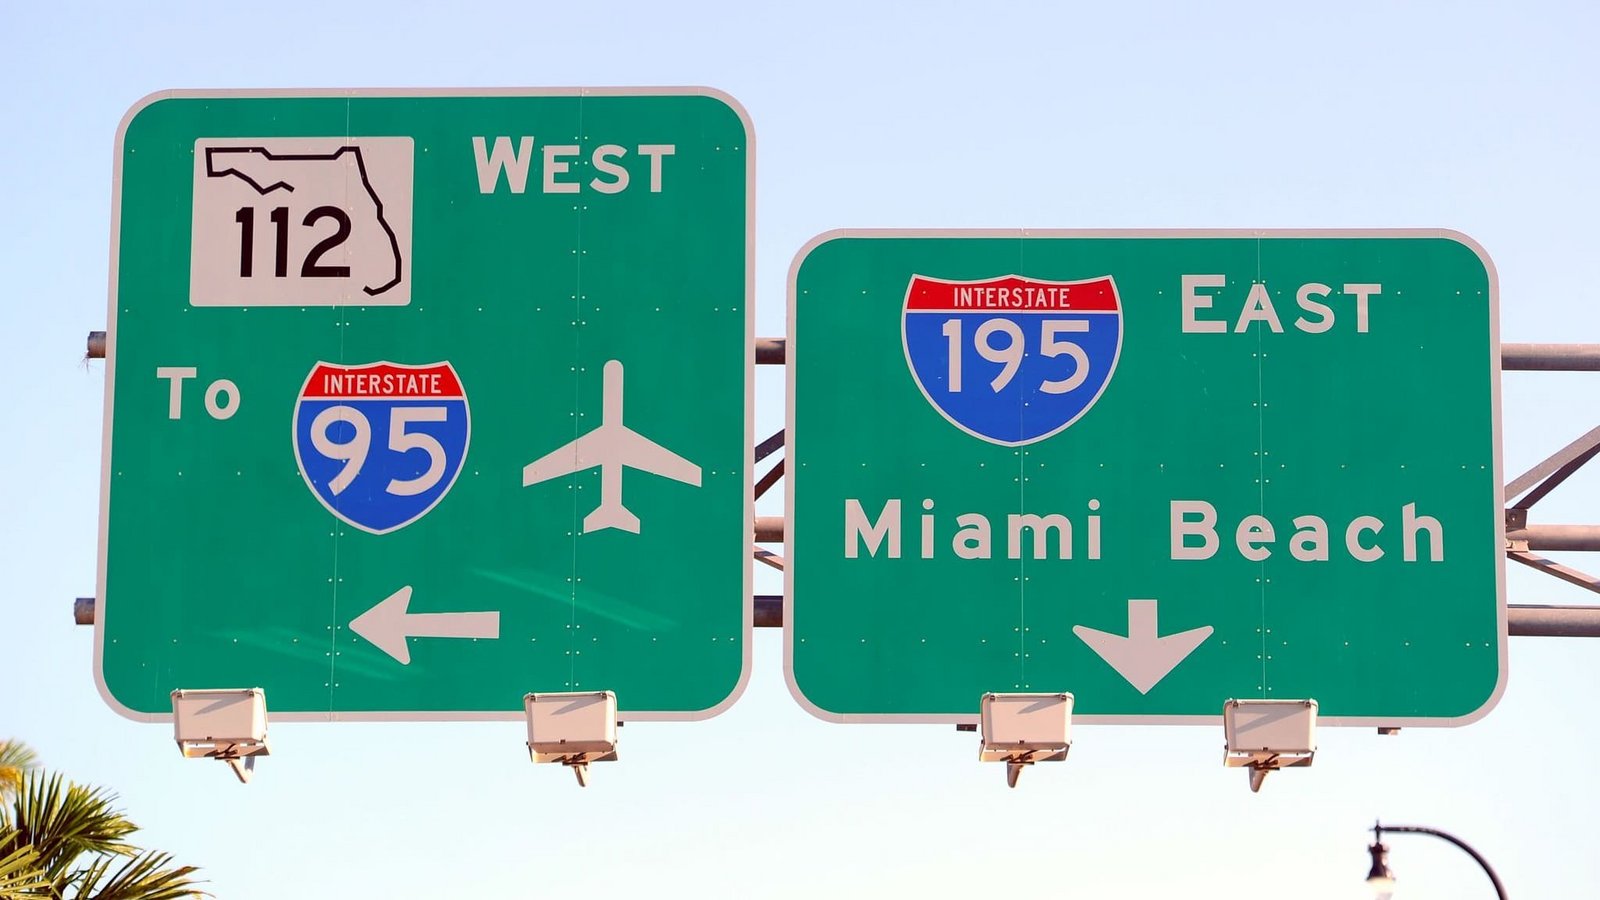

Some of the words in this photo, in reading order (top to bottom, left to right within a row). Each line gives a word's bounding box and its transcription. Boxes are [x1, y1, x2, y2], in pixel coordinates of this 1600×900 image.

[472, 136, 675, 194] WEST
[235, 205, 352, 278] 112
[954, 287, 1071, 308] INTERSTATE
[1181, 274, 1382, 334] EAST
[323, 374, 443, 395] INTERSTATE
[942, 317, 1090, 395] 195
[156, 367, 241, 420] To
[310, 405, 448, 496] 95
[844, 498, 1101, 560] Miami
[1170, 500, 1444, 562] Beach
